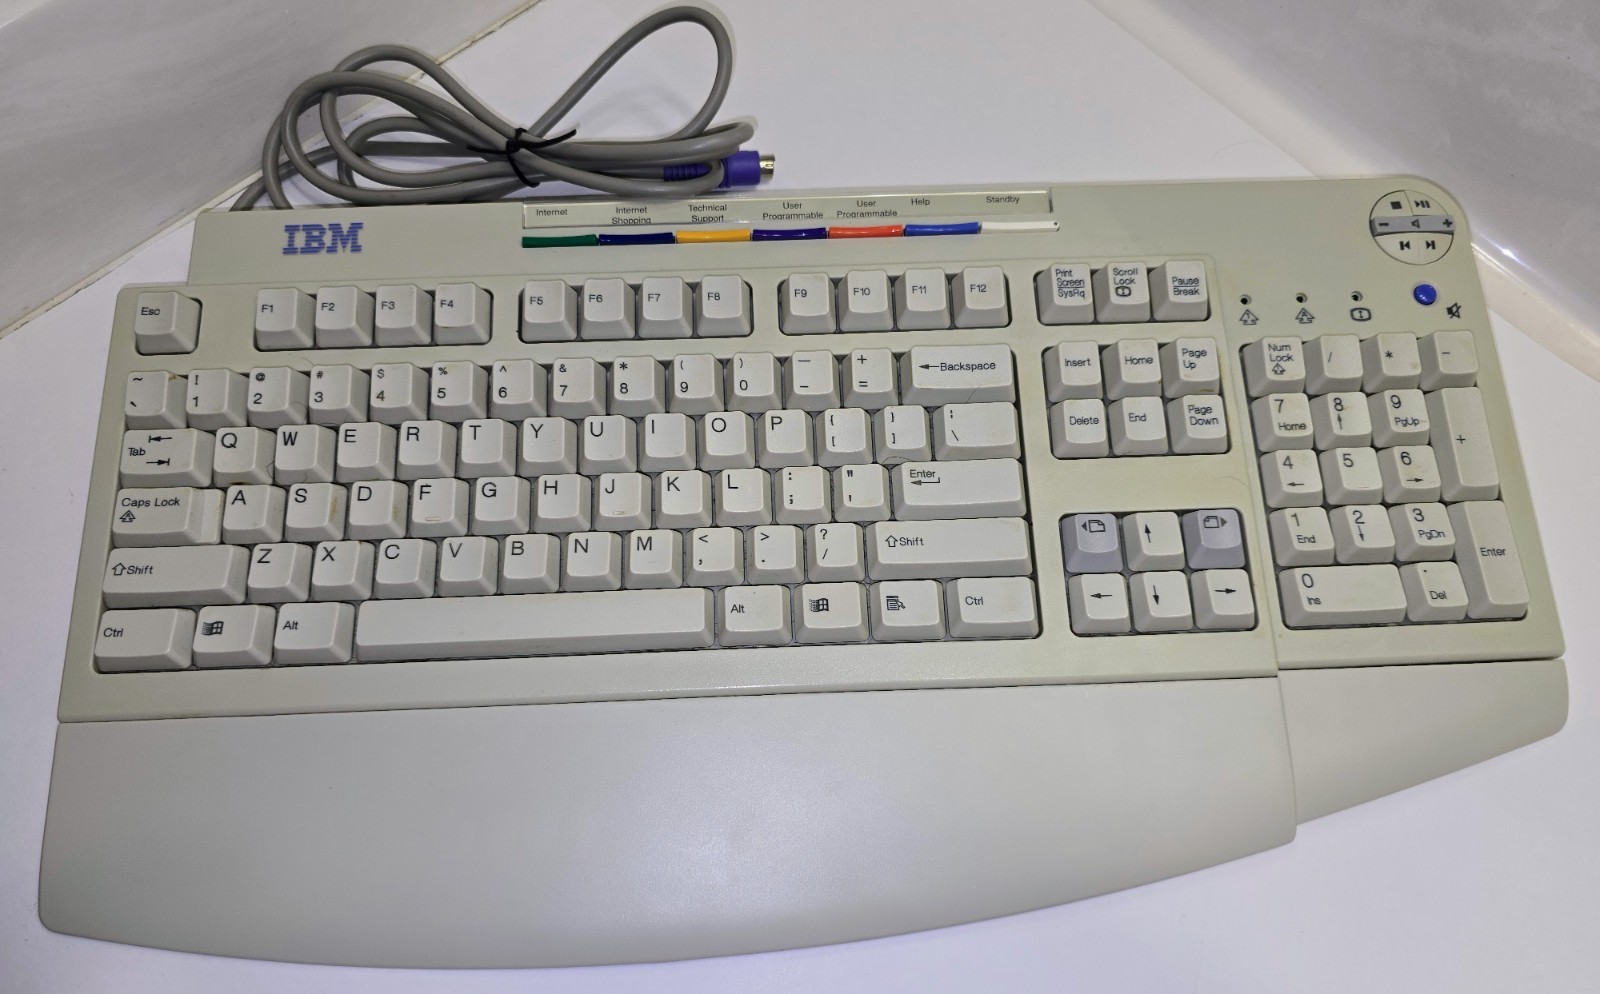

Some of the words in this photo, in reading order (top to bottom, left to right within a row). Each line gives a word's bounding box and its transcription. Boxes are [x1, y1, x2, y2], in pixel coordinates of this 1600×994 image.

[911, 198, 930, 206] Help
[986, 196, 1019, 204] Standby
[688, 204, 727, 212] Technical
[692, 214, 724, 222] Support
[762, 211, 824, 220] Programmable
[837, 209, 897, 218] Programmable
[612, 216, 651, 225] Shopping
[282, 222, 364, 255] IBM
[1056, 269, 1072, 277] Print
[1113, 268, 1138, 276] Scroll
[1056, 278, 1085, 287] Screen
[1113, 276, 1136, 285] Lock
[1172, 277, 1199, 286] Pause
[795, 289, 807, 297] F9
[912, 286, 926, 294] F11
[970, 284, 986, 292] F12
[1173, 287, 1200, 296] Break
[589, 294, 603, 302] F6
[648, 293, 660, 301] F7
[708, 292, 720, 301] F8
[1058, 288, 1085, 299] SysRq
[381, 301, 395, 310] F3
[440, 300, 453, 308] F4
[530, 297, 543, 305] F5
[141, 307, 160, 315] Esc
[321, 303, 335, 311] F2
[1182, 348, 1207, 358] Page
[1270, 354, 1294, 362] Lock
[1065, 358, 1091, 366] Insert
[1125, 357, 1153, 365] Home
[1183, 360, 1196, 370] Up
[940, 361, 996, 373] Backspace
[620, 383, 628, 394] 8
[680, 382, 688, 393] 9
[740, 380, 748, 390] 0
[376, 390, 385, 401] 4
[437, 388, 446, 398] 5
[499, 387, 507, 398] 6
[560, 385, 567, 396] 7
[193, 396, 198, 407] 1
[253, 393, 262, 404] 2
[314, 392, 323, 402] 3
[1391, 395, 1401, 409] 9
[1274, 399, 1284, 413] 7
[1334, 397, 1344, 411] 8
[1188, 405, 1212, 415] Page
[1070, 416, 1099, 425] Delete
[1129, 413, 1146, 422] End
[1190, 416, 1218, 425] Down
[1394, 417, 1419, 427] PgUp
[652, 420, 654, 434] I
[712, 418, 726, 432] O
[771, 416, 782, 430] P
[407, 427, 419, 441] R
[469, 425, 481, 440] T
[531, 424, 543, 438] Y
[590, 422, 603, 437] U
[221, 433, 237, 448] Q
[283, 431, 298, 446] W
[344, 429, 357, 442] E
[128, 448, 145, 456] Tab
[1283, 456, 1293, 469] 4
[1343, 453, 1353, 467] 5
[1401, 452, 1411, 465] 6
[910, 469, 935, 478] Enter
[605, 479, 614, 494] J
[667, 477, 680, 491] K
[728, 474, 738, 489] L
[420, 484, 431, 500] F
[482, 482, 496, 498] G
[544, 480, 558, 495] H
[231, 490, 246, 505] A
[295, 488, 307, 503] S
[357, 486, 372, 501] D
[122, 498, 150, 508] Caps
[155, 497, 180, 506] Lock
[1291, 513, 1300, 526] 1
[1353, 510, 1365, 524] 2
[1413, 508, 1424, 522] 3
[1296, 535, 1316, 543] End
[1418, 530, 1445, 540] PgDn
[574, 539, 588, 553] N
[637, 536, 652, 551] M
[900, 537, 924, 546] Shift
[385, 544, 399, 559] C
[449, 543, 462, 558] V
[511, 541, 524, 555] B
[1480, 547, 1505, 556] Enter
[257, 549, 272, 563] Z
[321, 547, 336, 561] X
[127, 565, 153, 574] Shift
[1302, 573, 1314, 588] 0
[1429, 591, 1447, 599] Del
[965, 596, 983, 605] Ctrl
[1307, 597, 1321, 605] Ins
[731, 604, 744, 613] Alt
[283, 621, 298, 630] Alt
[104, 628, 123, 637] Ctrl
